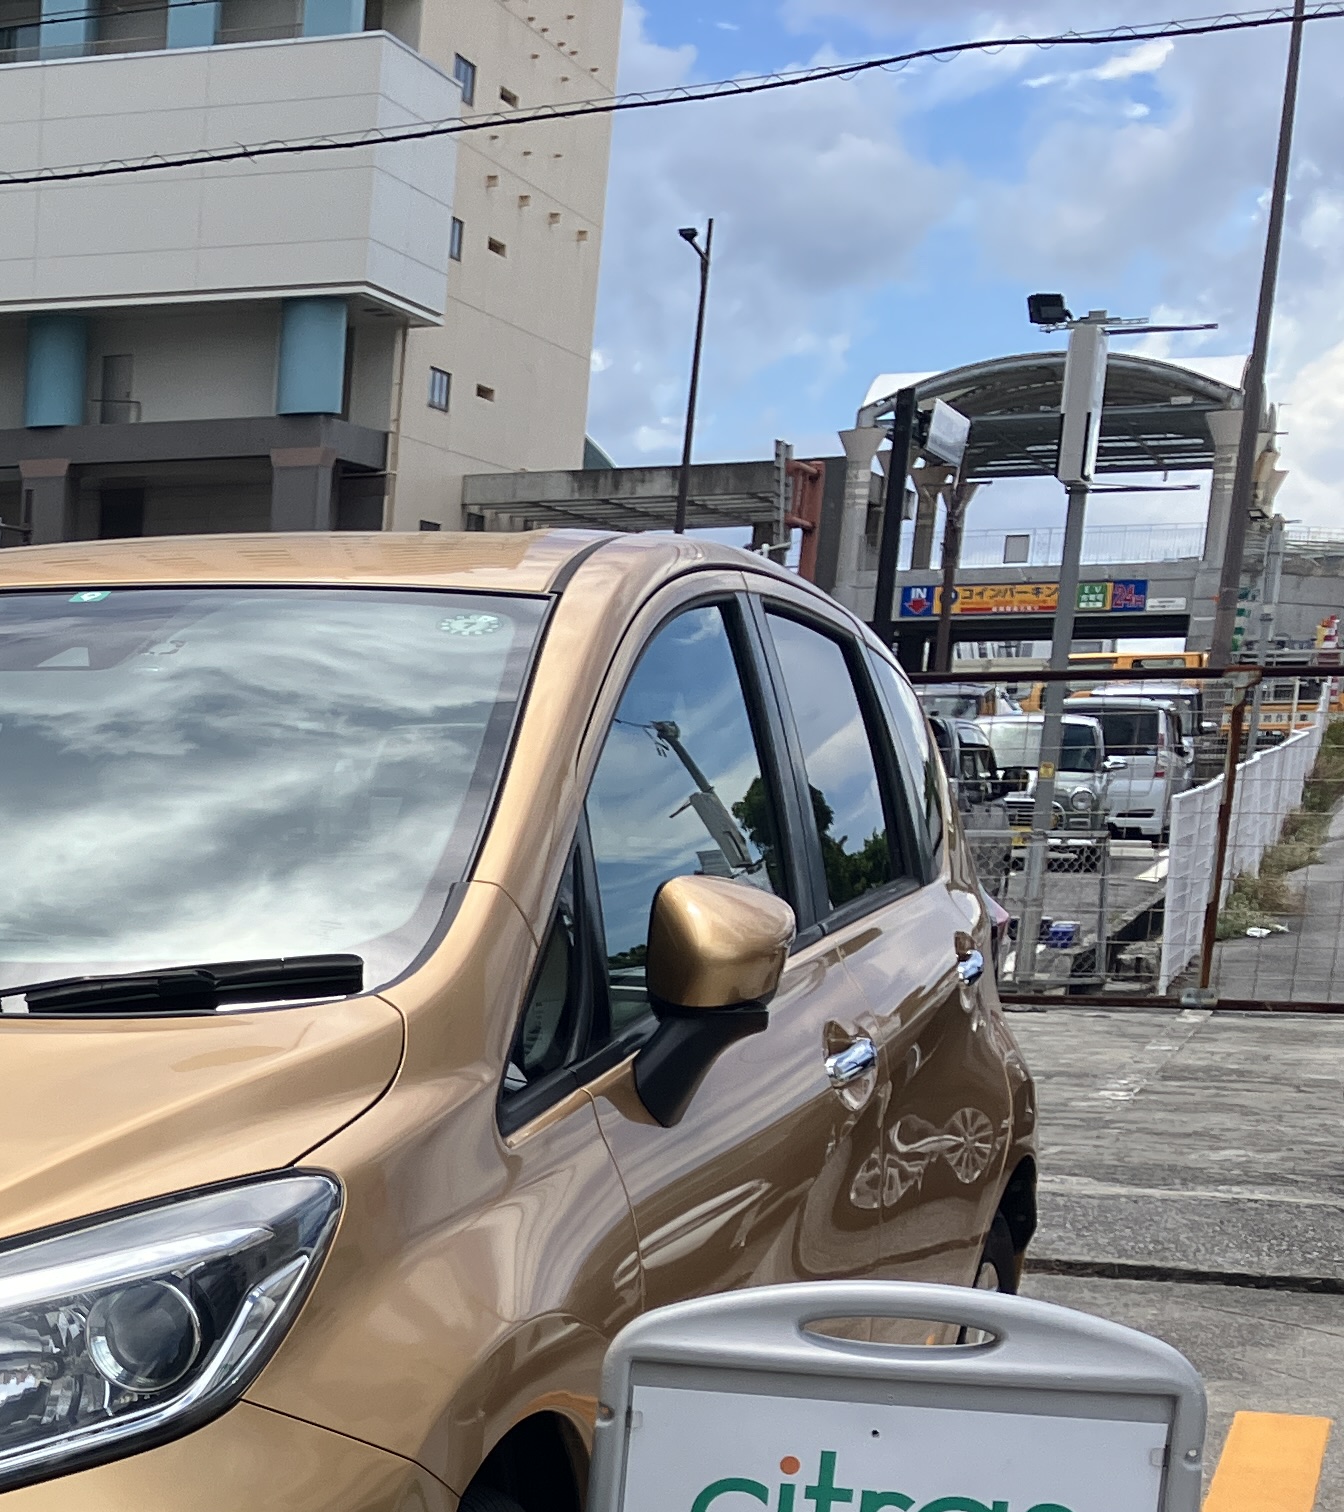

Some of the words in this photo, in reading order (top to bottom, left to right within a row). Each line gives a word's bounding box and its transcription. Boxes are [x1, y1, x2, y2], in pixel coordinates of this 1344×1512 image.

[911, 587, 928, 599] IN
[961, 586, 1061, 601] コインパーキン
